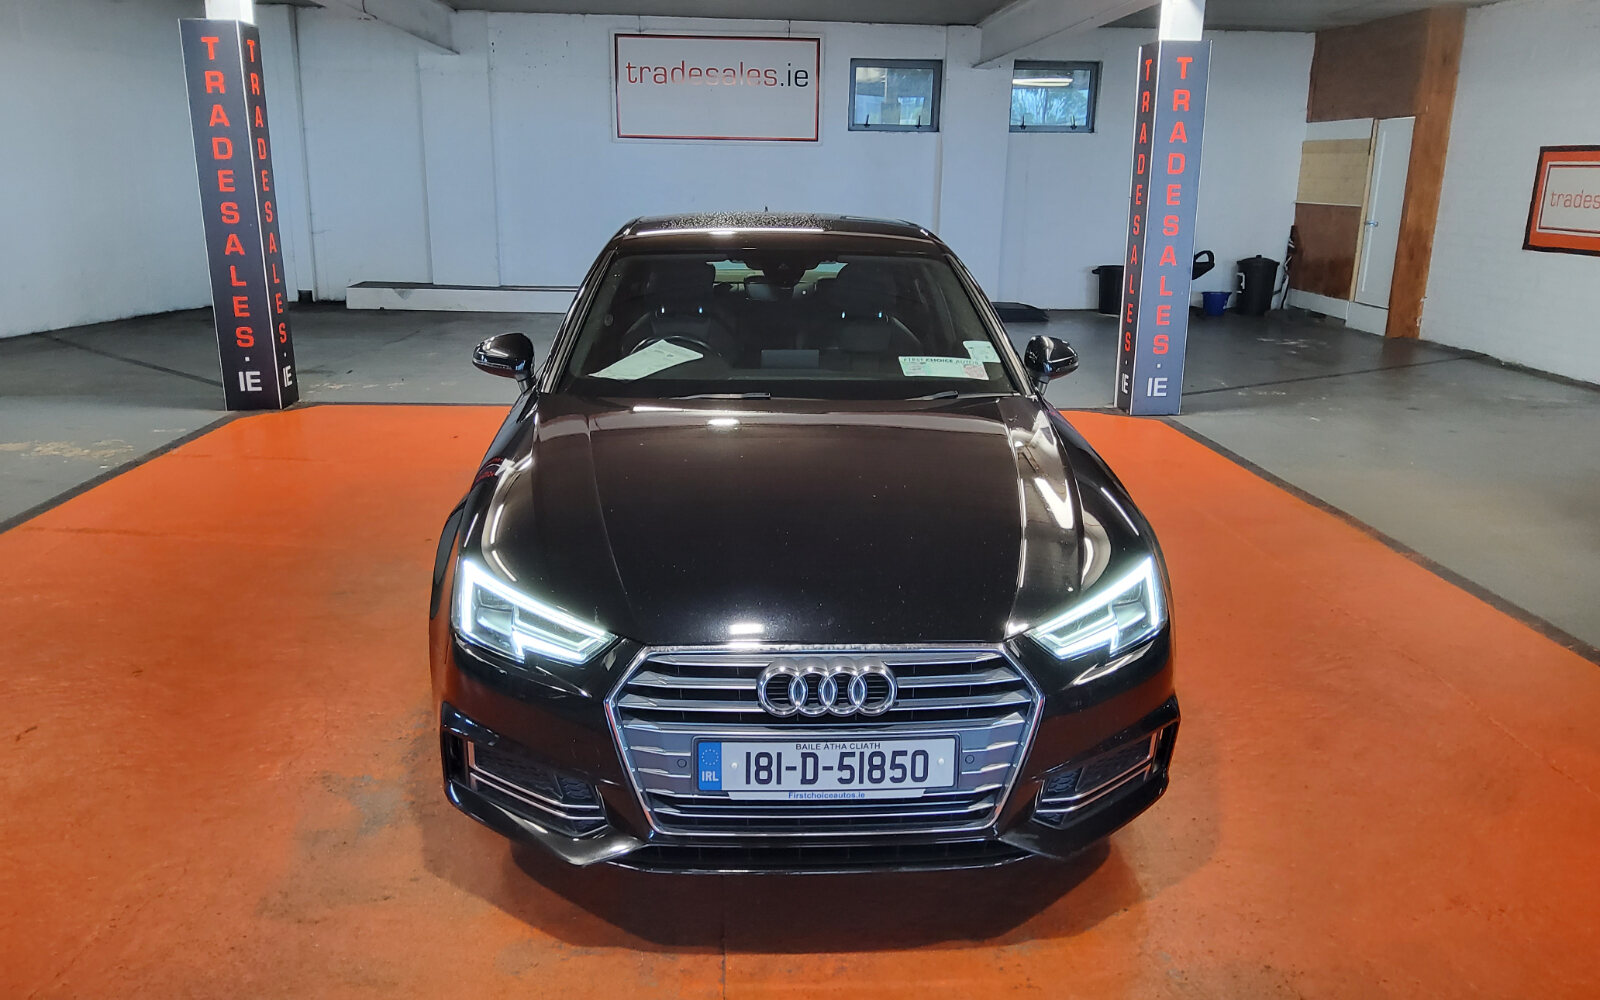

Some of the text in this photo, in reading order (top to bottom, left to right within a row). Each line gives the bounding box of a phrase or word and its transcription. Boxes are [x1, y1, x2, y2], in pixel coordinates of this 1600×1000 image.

[625, 60, 809, 88] tradesales.ie
[795, 743, 821, 751] BAILE
[849, 742, 881, 750] CLIATH
[745, 750, 929, 785] 181-D-51850
[701, 771, 719, 783] IRL
[788, 791, 866, 800] Firstchoiceautos.ie
